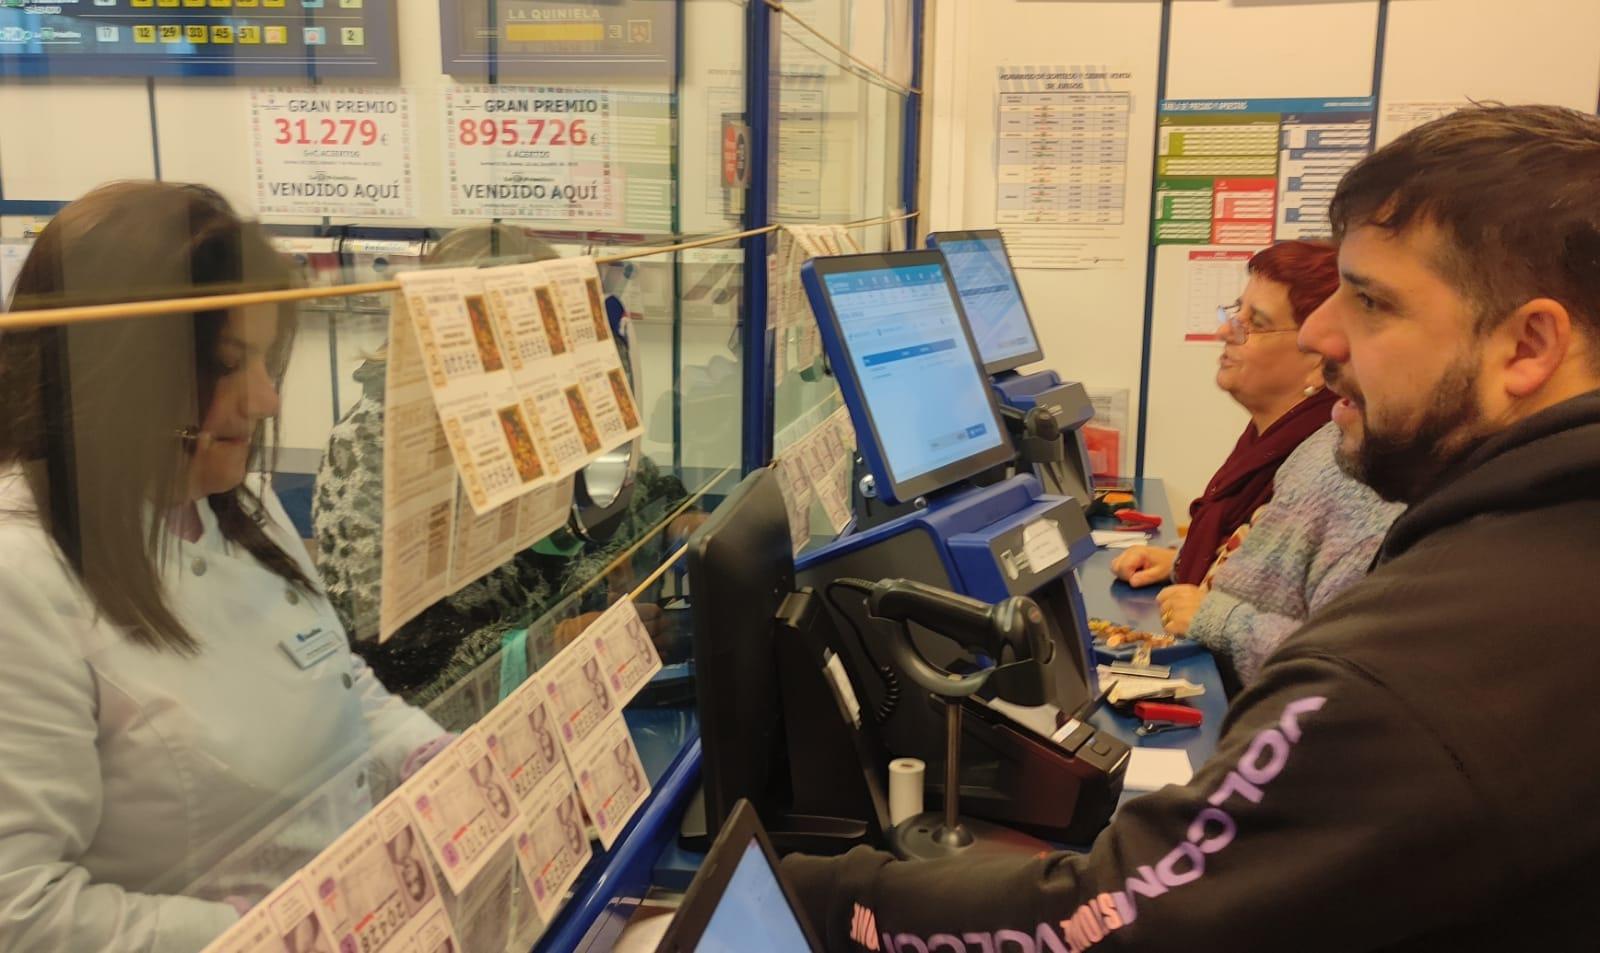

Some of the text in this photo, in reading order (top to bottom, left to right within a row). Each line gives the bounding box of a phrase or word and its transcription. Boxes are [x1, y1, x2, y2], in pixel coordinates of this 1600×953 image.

[508, 9, 600, 19] LA QUINIELA
[288, 99, 397, 114] GRAN PREMIO
[484, 99, 598, 113] GRAN PREMIO
[269, 181, 400, 202] VENDIDO AQUÍ
[463, 180, 599, 203] VENDIDO AQUÍ
